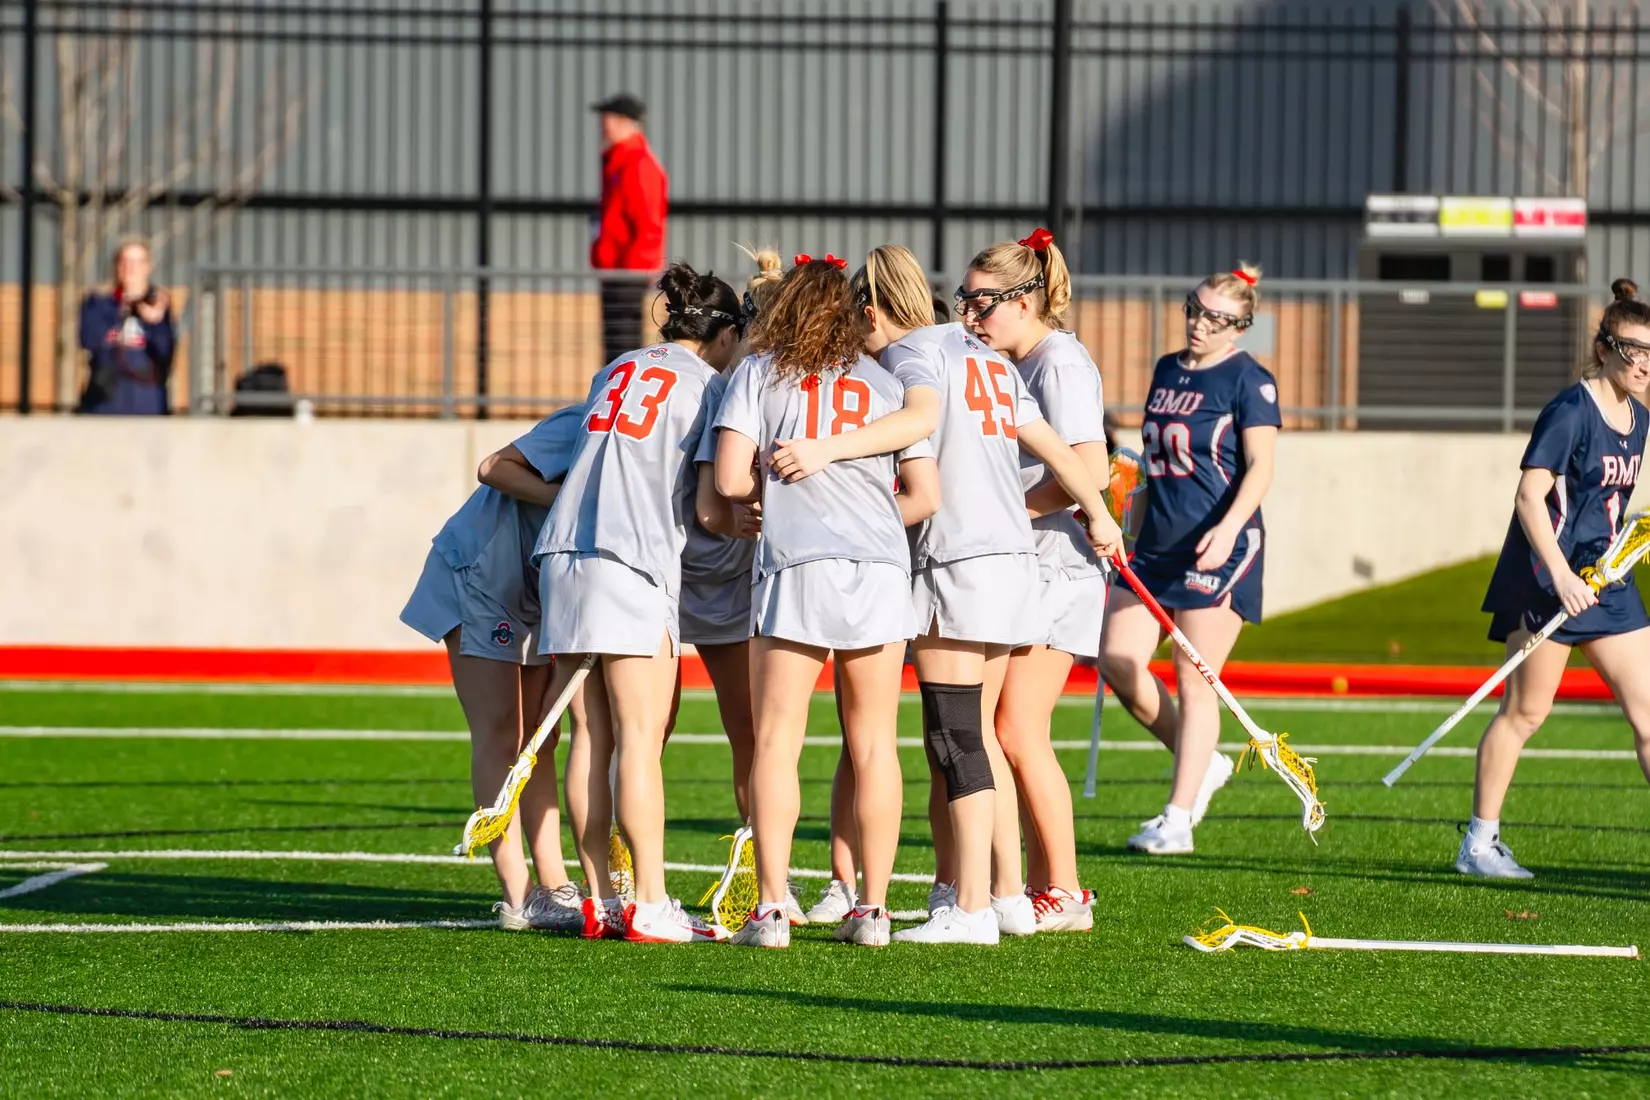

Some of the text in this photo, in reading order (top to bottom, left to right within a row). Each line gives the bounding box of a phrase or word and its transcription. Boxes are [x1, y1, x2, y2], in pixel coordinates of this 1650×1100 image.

[711, 310, 735, 321] STX
[1002, 289, 1026, 301] STX
[586, 360, 679, 441] 33
[799, 375, 871, 440] 18
[964, 356, 1018, 441] 45
[1147, 387, 1204, 416] RMU
[1141, 421, 1195, 478] 20
